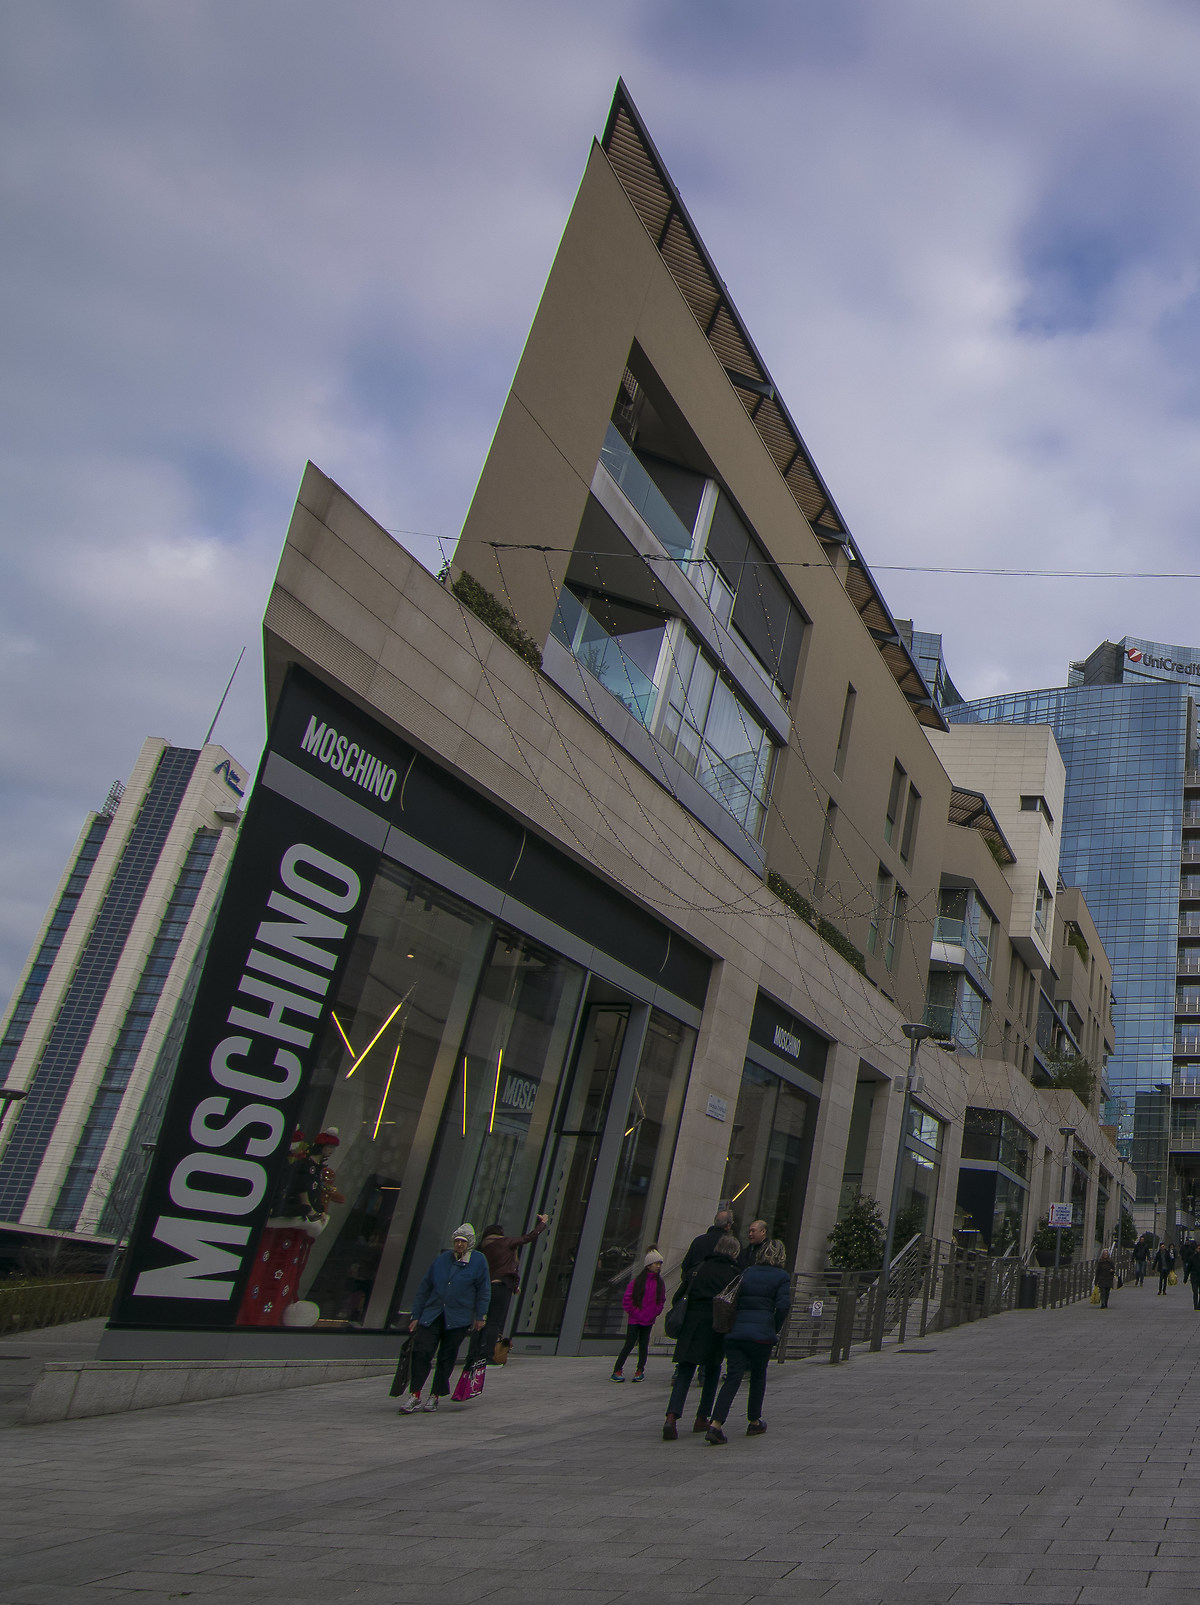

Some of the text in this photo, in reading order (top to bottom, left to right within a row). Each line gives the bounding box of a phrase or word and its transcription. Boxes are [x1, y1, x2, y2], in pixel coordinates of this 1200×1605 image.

[300, 714, 398, 802] MOSCHINO
[132, 842, 362, 1301] MOSCHINO
[501, 1074, 539, 1111] MOSC
